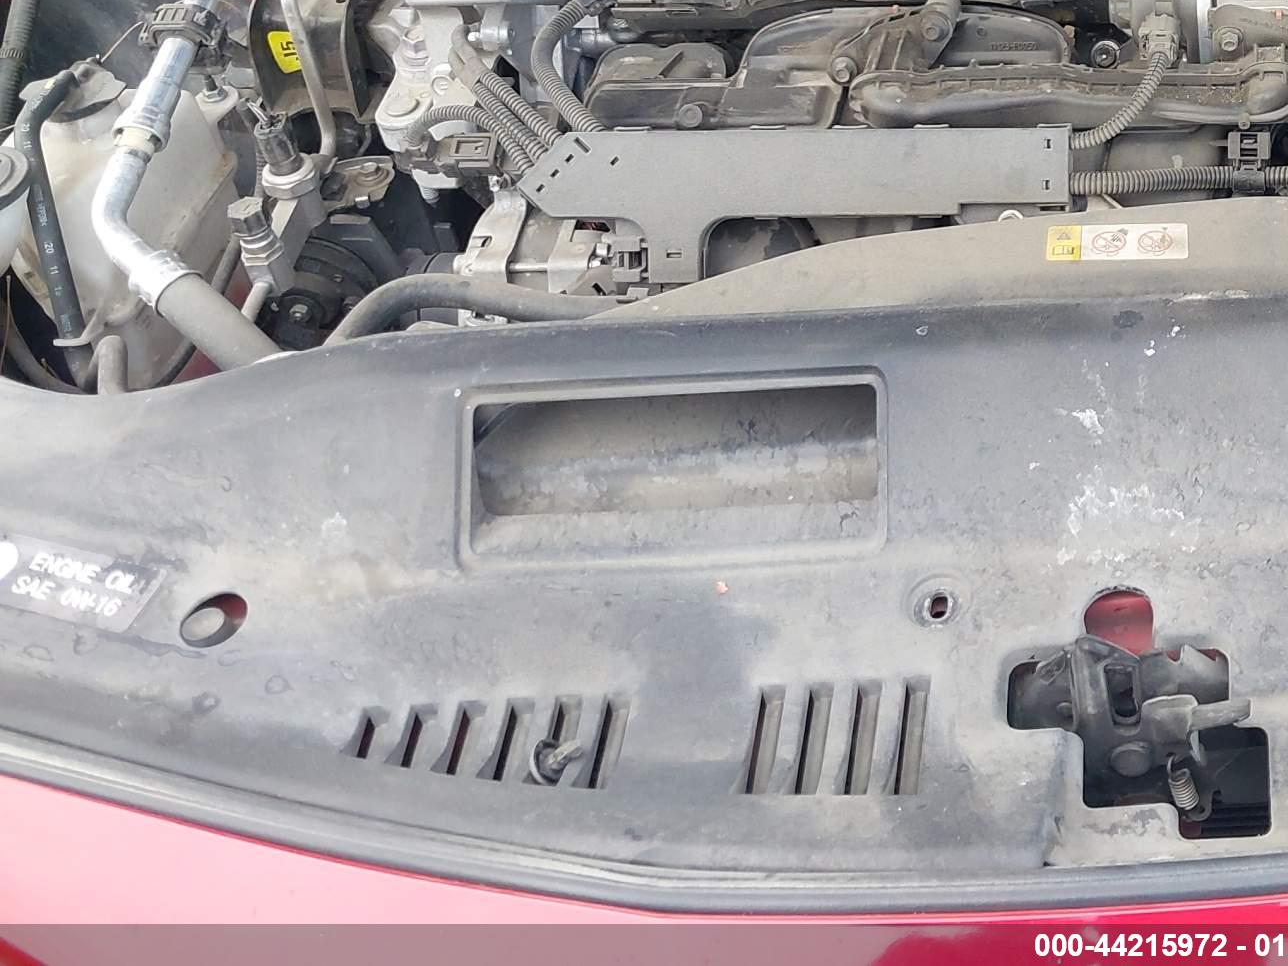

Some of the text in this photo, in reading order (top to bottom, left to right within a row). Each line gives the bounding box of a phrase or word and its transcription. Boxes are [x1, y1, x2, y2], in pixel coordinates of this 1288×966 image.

[29, 552, 138, 594] ENGINE OIL
[11, 575, 122, 616] SAE 0W-16
